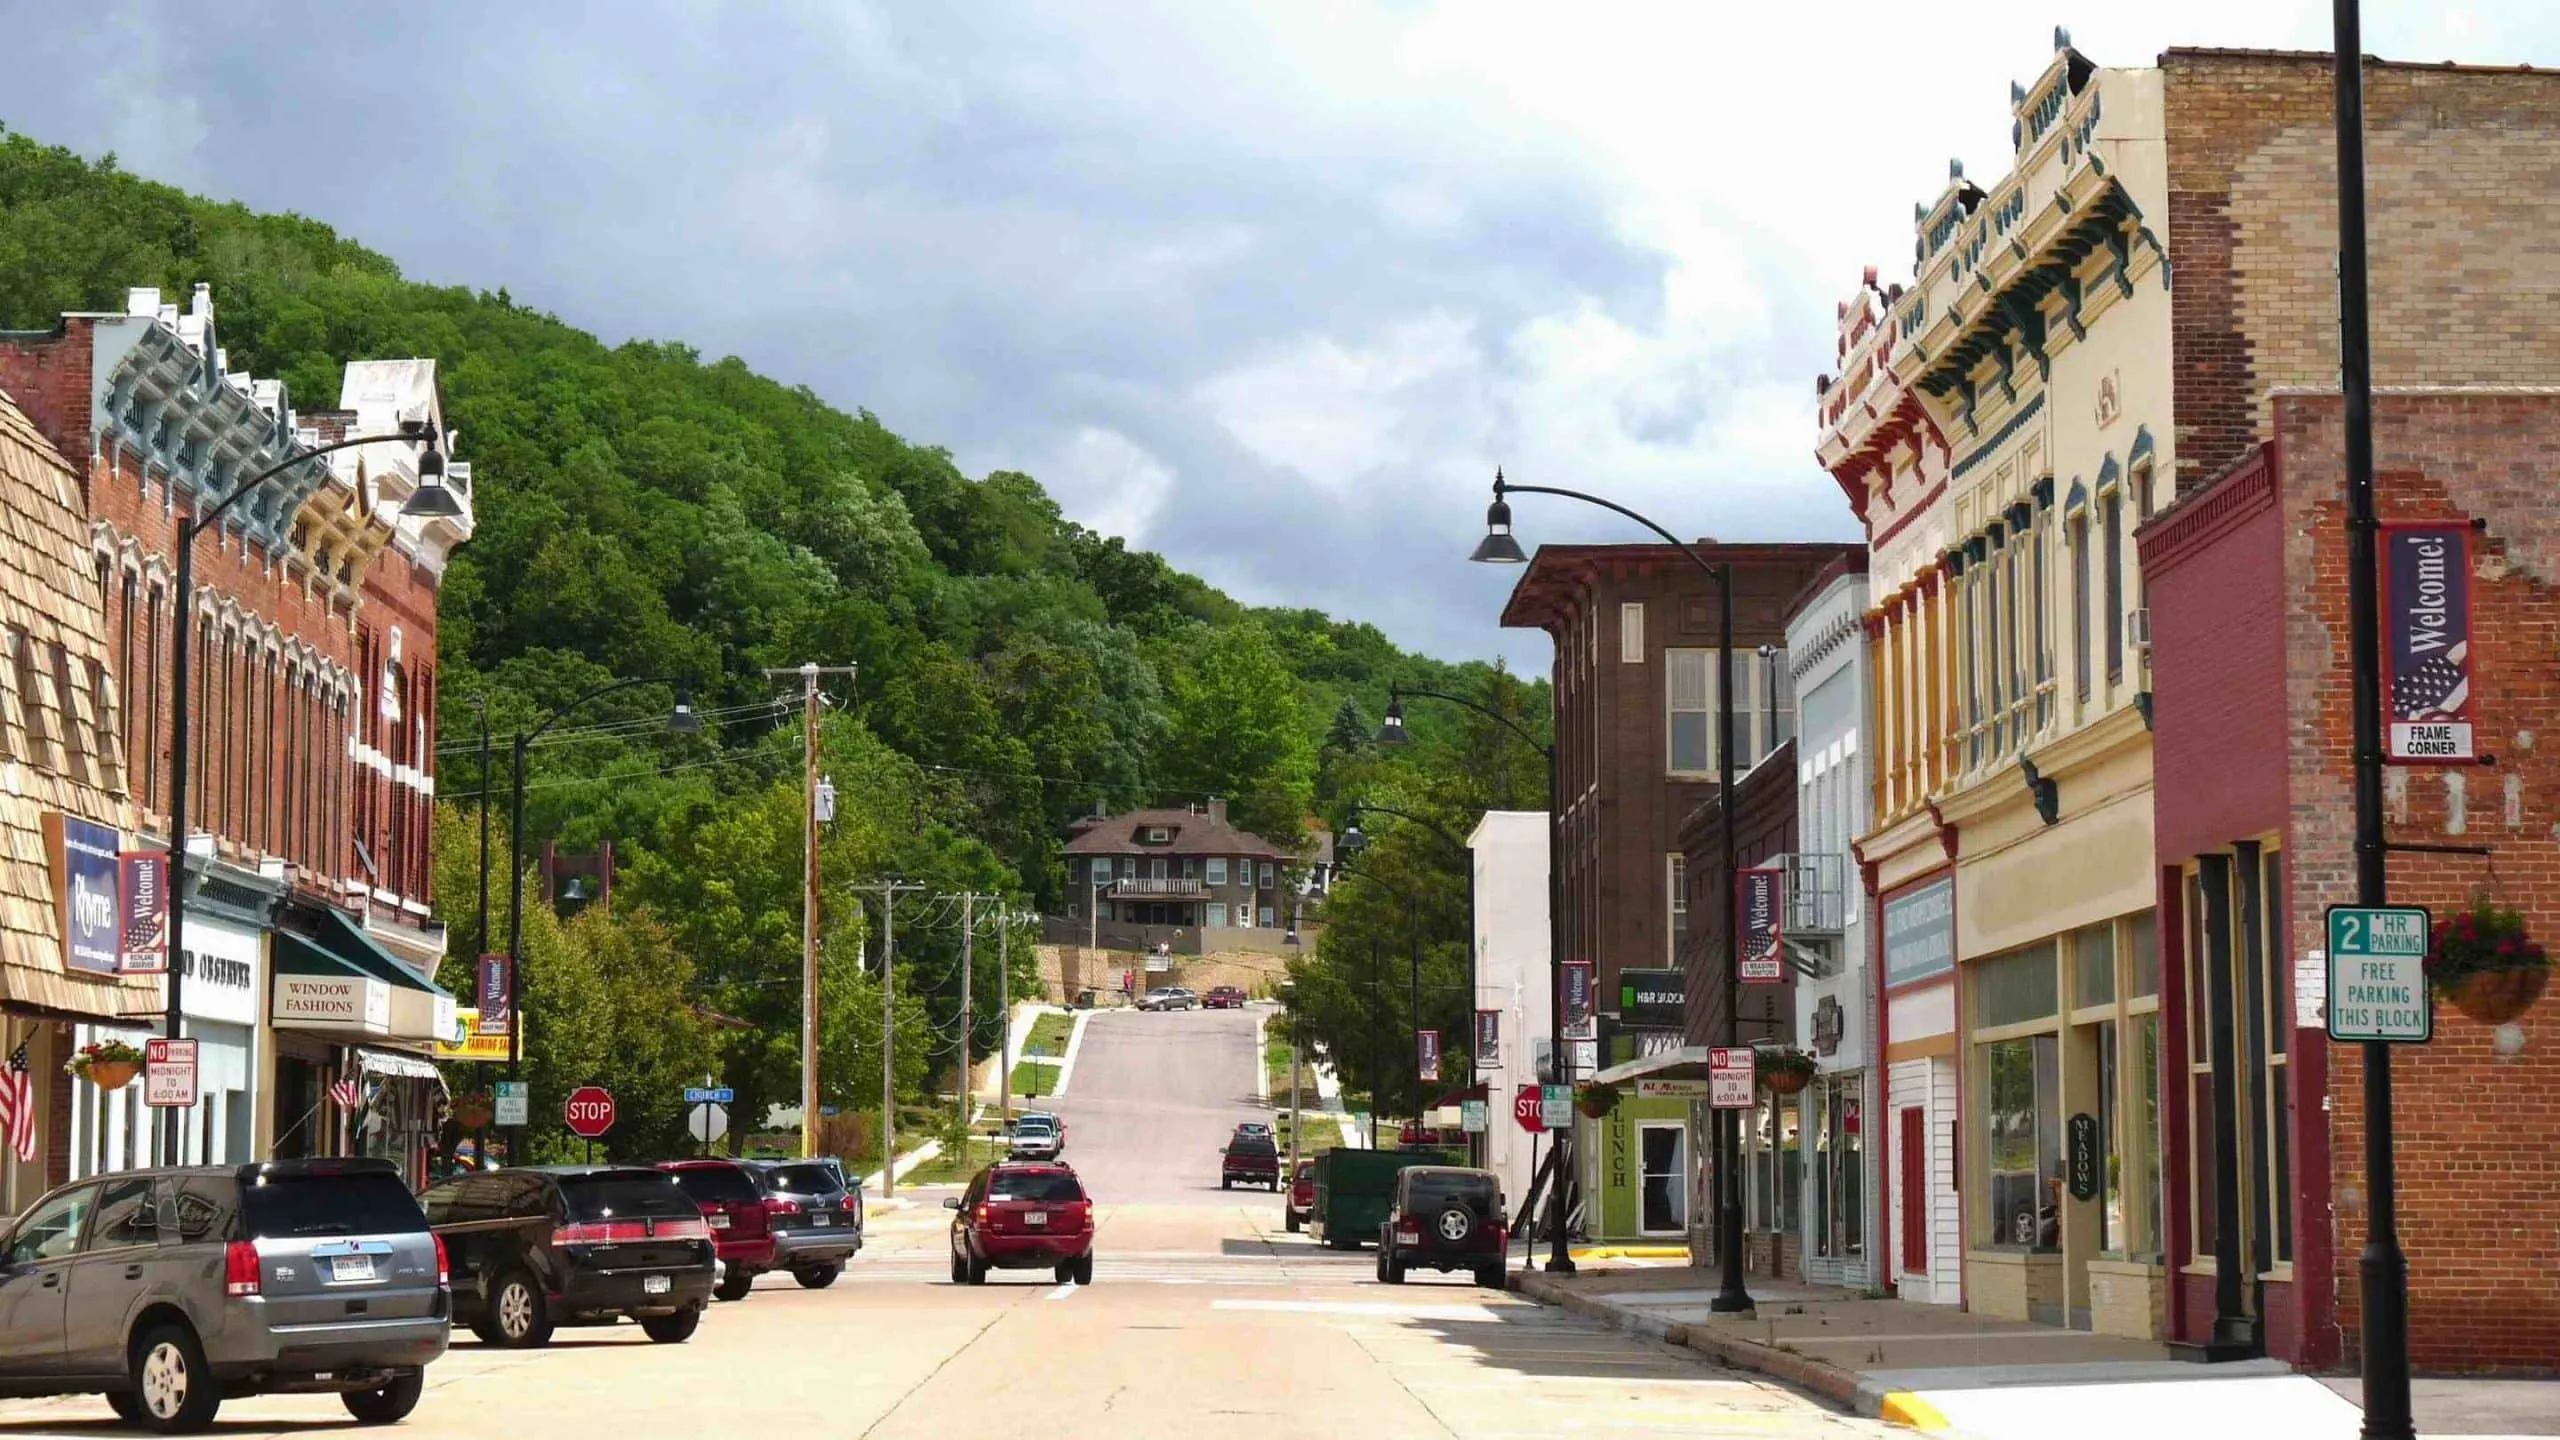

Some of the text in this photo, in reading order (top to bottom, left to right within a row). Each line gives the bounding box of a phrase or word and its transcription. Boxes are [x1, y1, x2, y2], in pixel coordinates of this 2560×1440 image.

[2407, 537, 2447, 654] Welcome!
[2411, 726, 2450, 741] FRAME
[2407, 742, 2456, 756] CORNER
[134, 859, 153, 918] Welcome!
[75, 872, 111, 938] Rhyme
[1750, 875, 1768, 929] Welcome!
[2341, 915, 2407, 950] 2 HR
[2371, 934, 2420, 951] PARKING
[2361, 962, 2396, 980] FREE
[289, 983, 351, 995] WINDOW
[2348, 985, 2410, 1004] PARKING
[286, 1000, 353, 1012] FASHIONS
[2337, 1008, 2421, 1027] THIS BLOCK
[150, 1044, 166, 1061] NO
[1711, 1051, 1727, 1067] NO
[151, 1066, 191, 1075] MIDNIGHT
[1713, 1072, 1750, 1081] MIDNIGHT
[166, 1078, 176, 1087] TO
[1728, 1082, 1737, 1091] TO
[175, 1090, 188, 1098] AM
[1717, 1093, 1735, 1102] 6:00
[1737, 1093, 1749, 1102] AM
[569, 1103, 611, 1120] STOP
[1517, 1100, 1542, 1117] ST
[1612, 1108, 1625, 1187] LUNCH
[2076, 1119, 2089, 1193] MEADOWS
